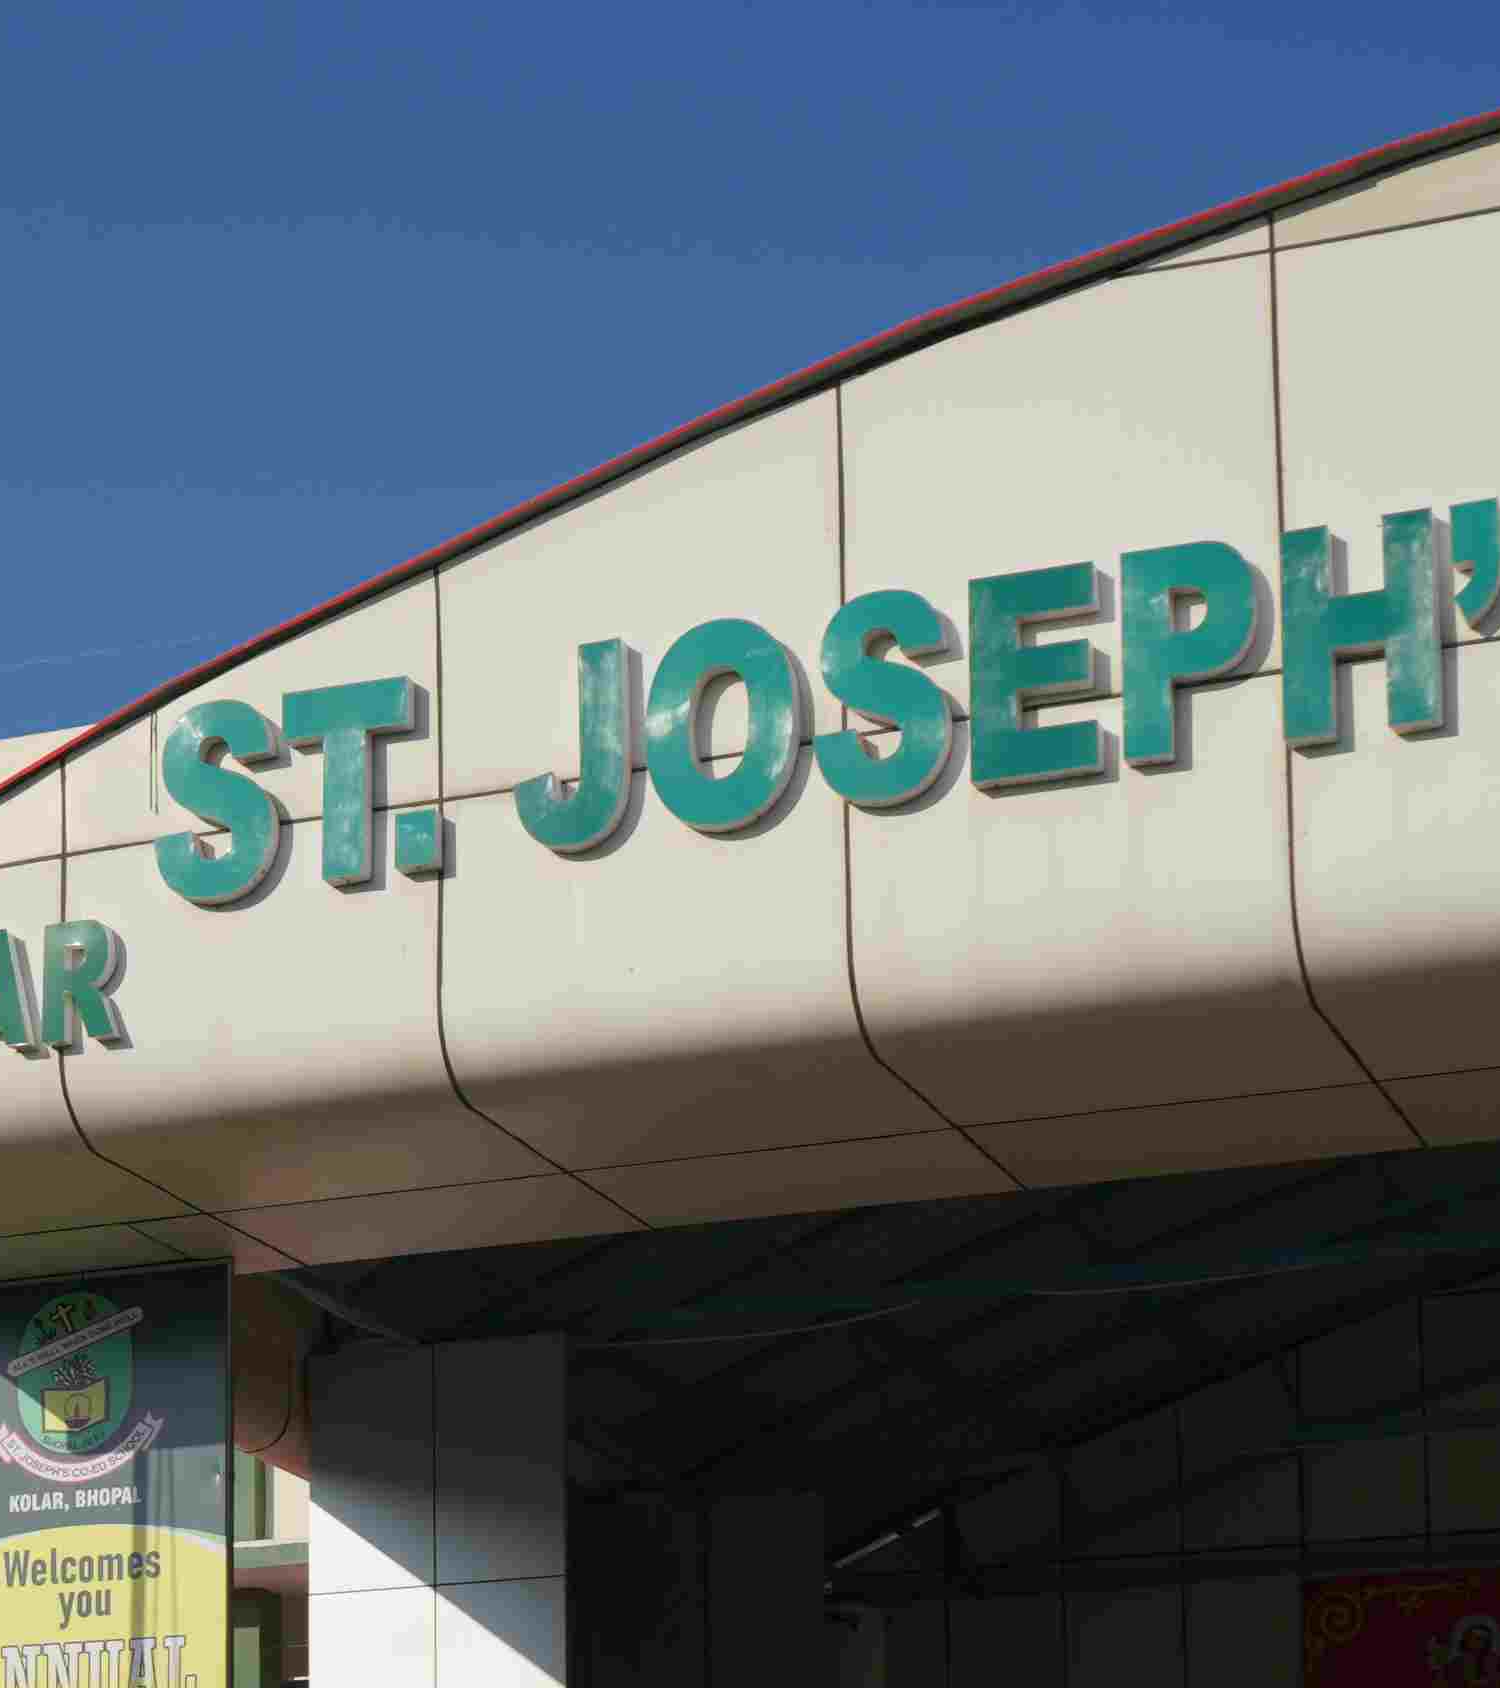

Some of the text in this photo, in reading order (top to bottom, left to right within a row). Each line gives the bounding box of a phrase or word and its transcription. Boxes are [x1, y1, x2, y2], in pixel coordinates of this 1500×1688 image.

[155, 675, 443, 908] ST.
[9, 1486, 142, 1512] KOLAR, BHOPAL
[3, 1548, 161, 1587] Welcomes
[58, 1588, 112, 1629] you
